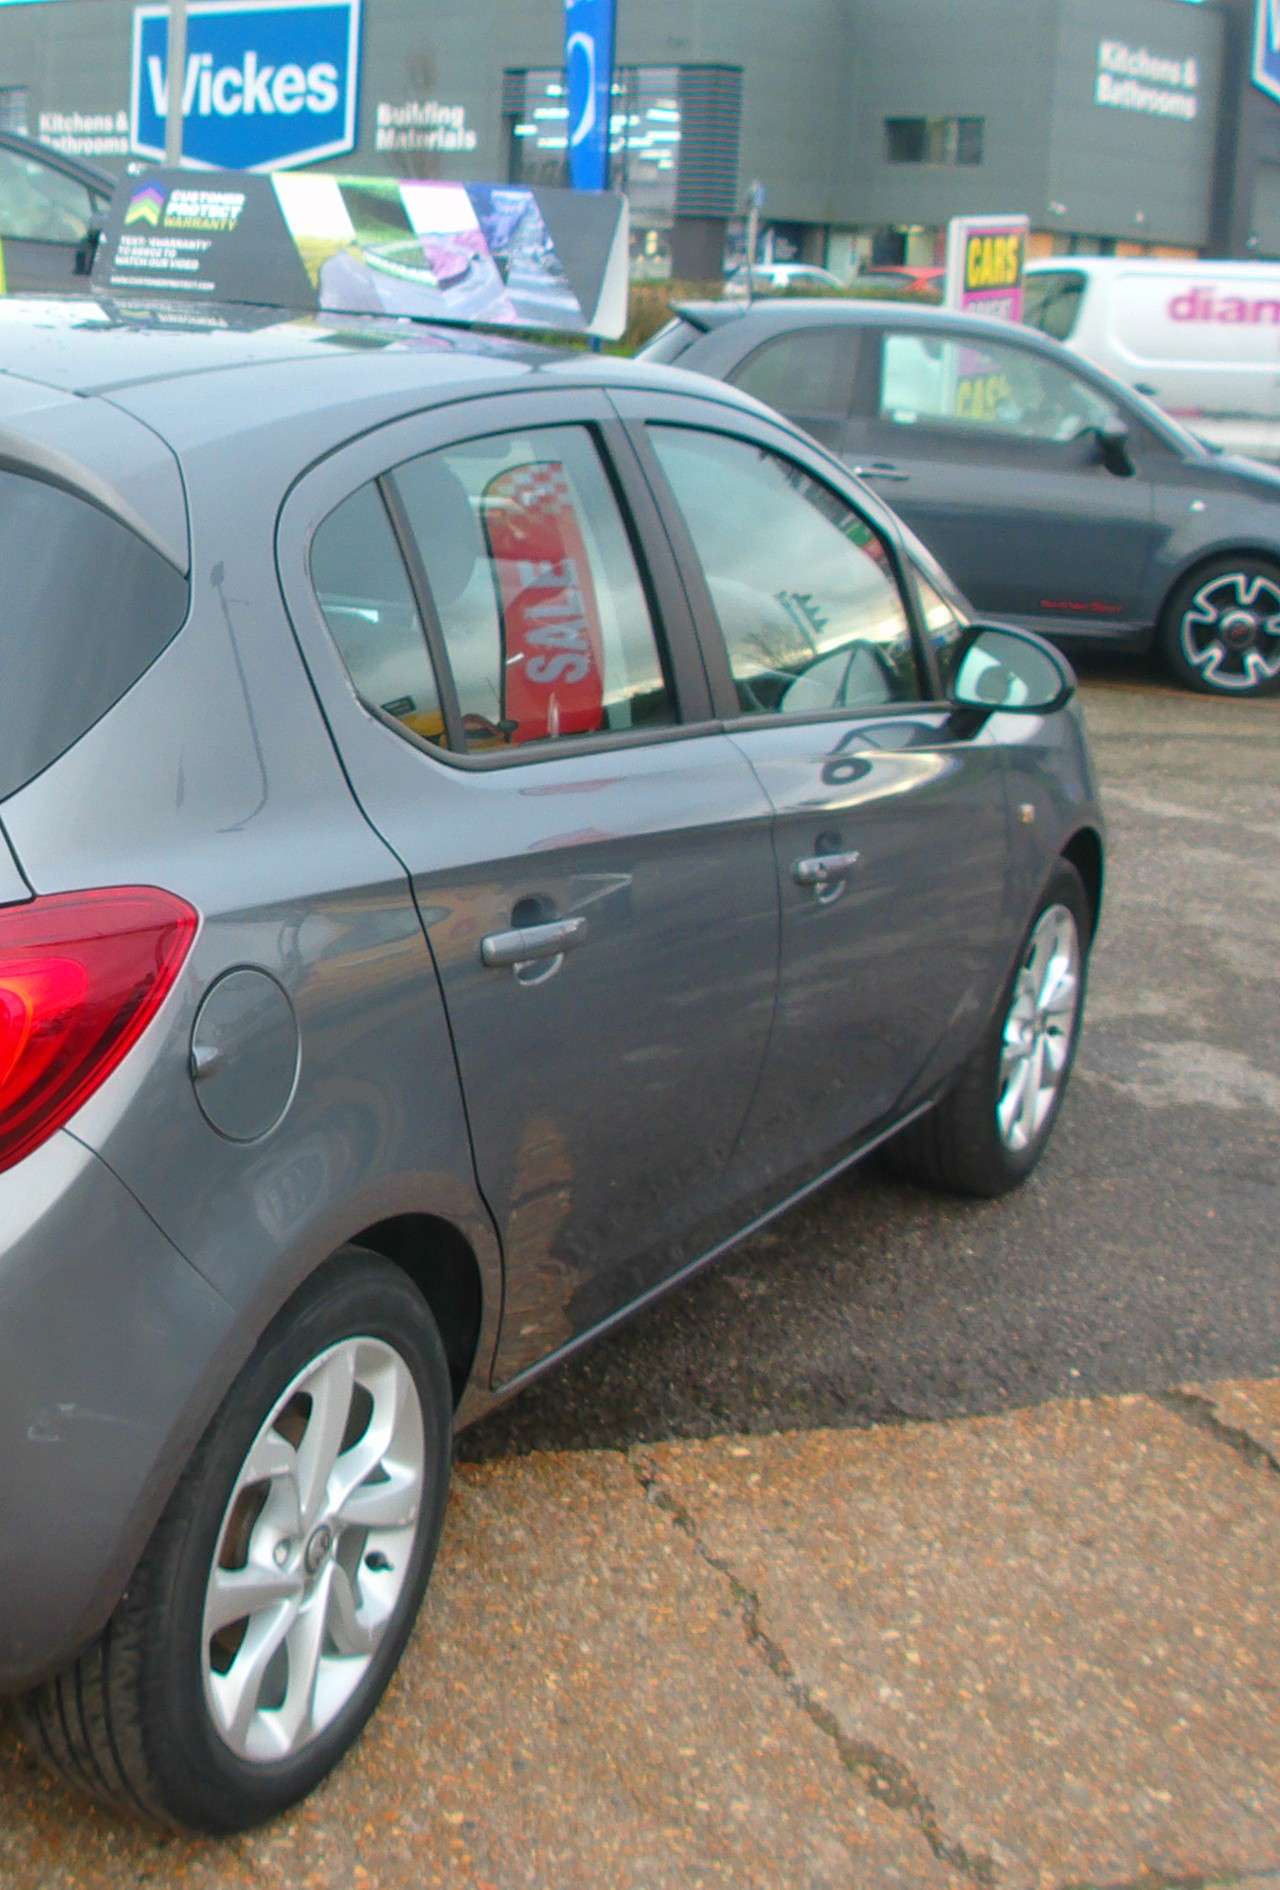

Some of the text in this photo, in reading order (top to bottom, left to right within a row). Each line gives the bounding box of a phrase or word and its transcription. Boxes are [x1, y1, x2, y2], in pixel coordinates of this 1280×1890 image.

[147, 51, 338, 116] Wickes
[40, 110, 128, 131] Kitchens &
[378, 101, 464, 128] Building
[377, 127, 476, 152] Materials
[166, 201, 243, 219] PROTECT
[164, 215, 238, 232] WARRANTY
[968, 235, 1018, 289] CARS
[516, 556, 592, 686] SALE
